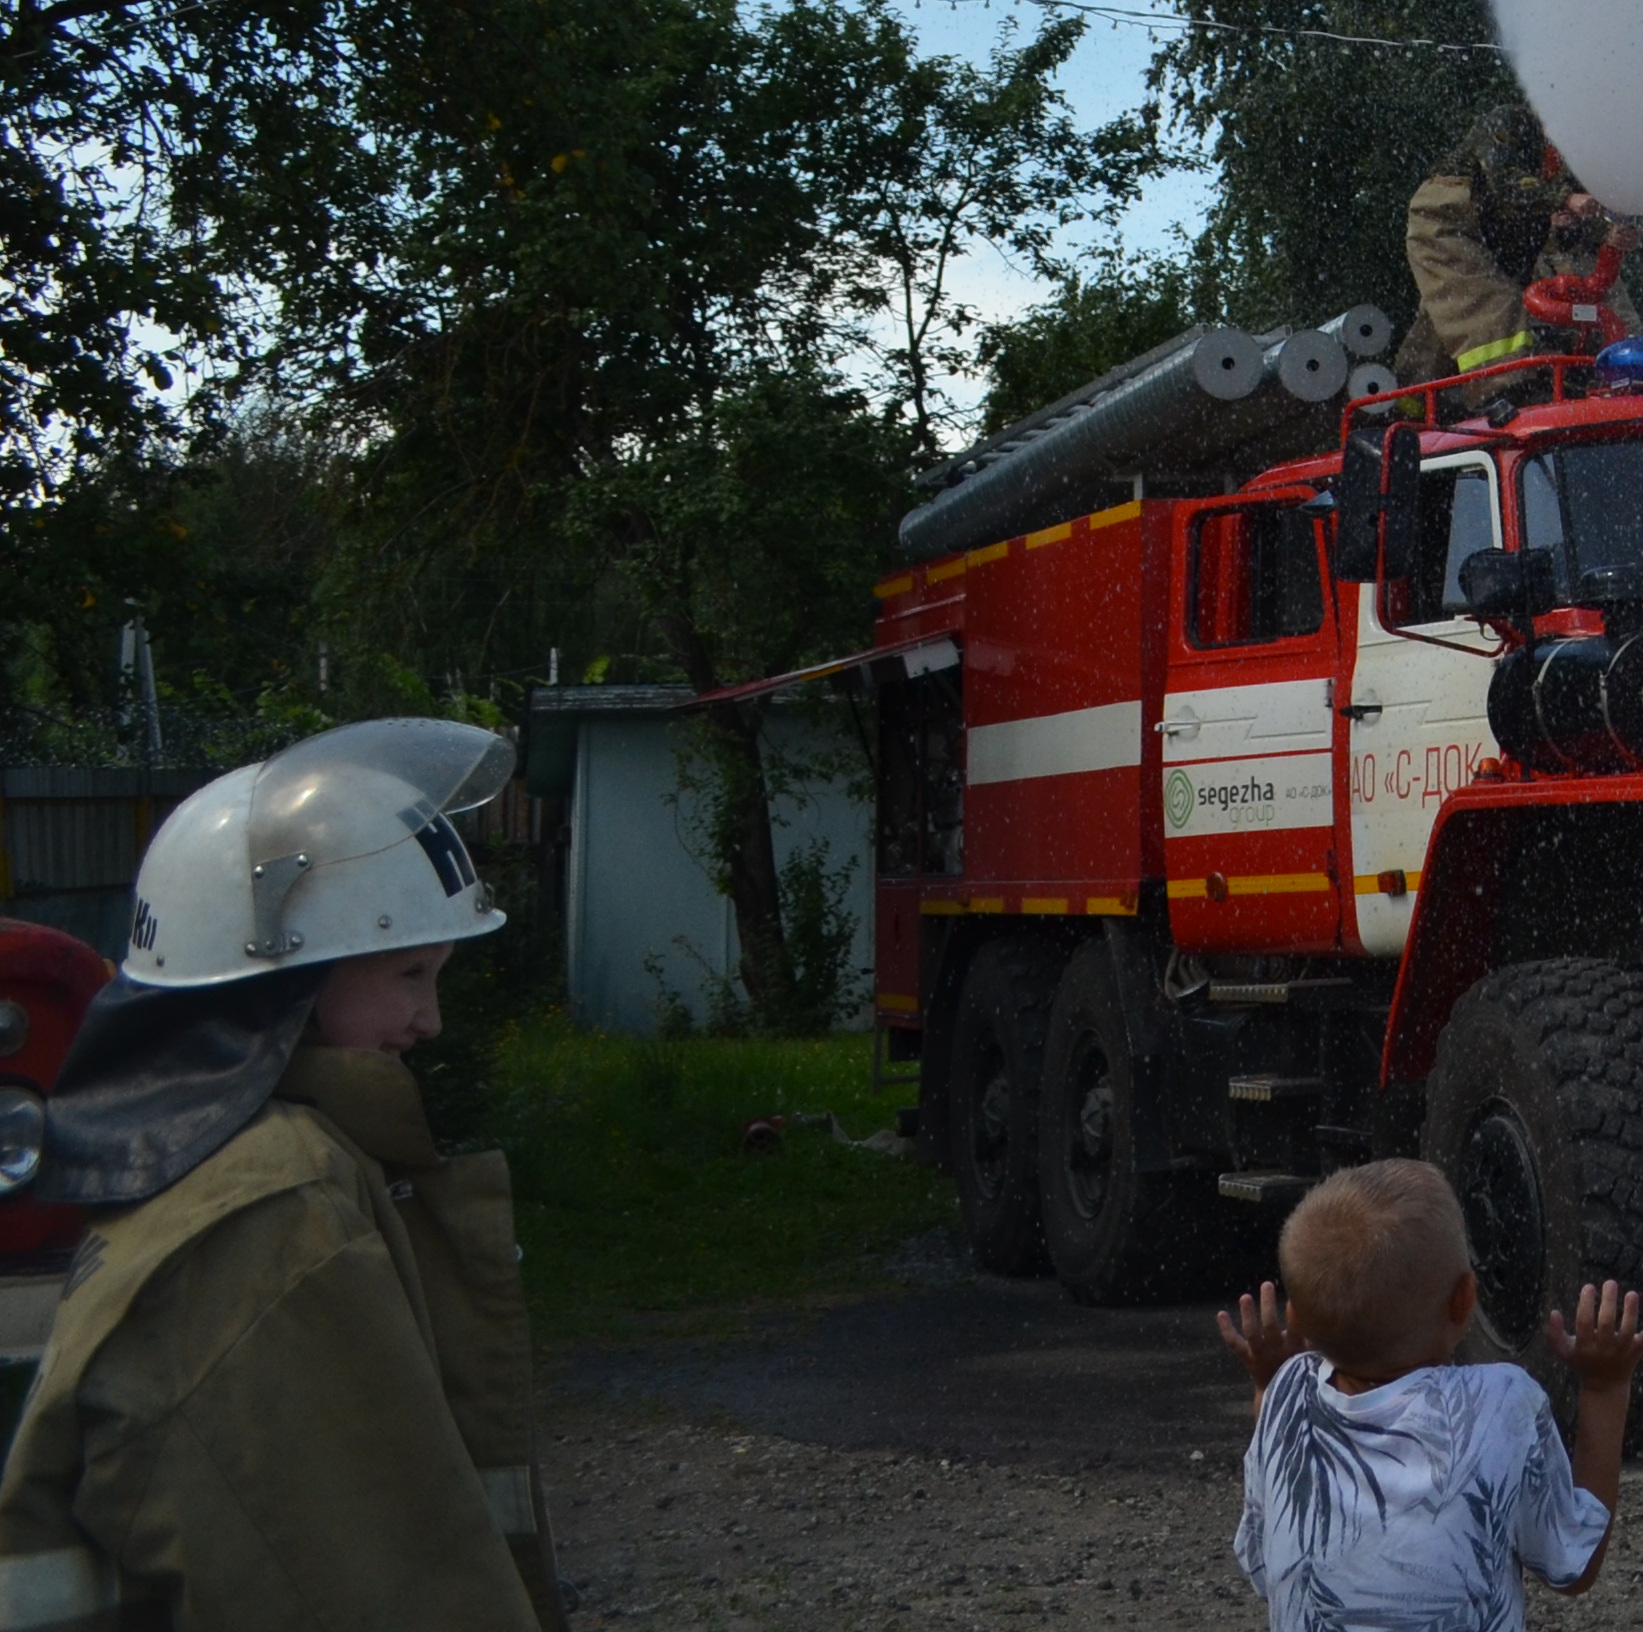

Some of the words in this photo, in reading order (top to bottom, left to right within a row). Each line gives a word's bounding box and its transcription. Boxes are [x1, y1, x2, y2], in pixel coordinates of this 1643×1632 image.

[1198, 776, 1275, 811] segezha
[1352, 754, 1375, 803] АО
[1229, 804, 1275, 829] group
